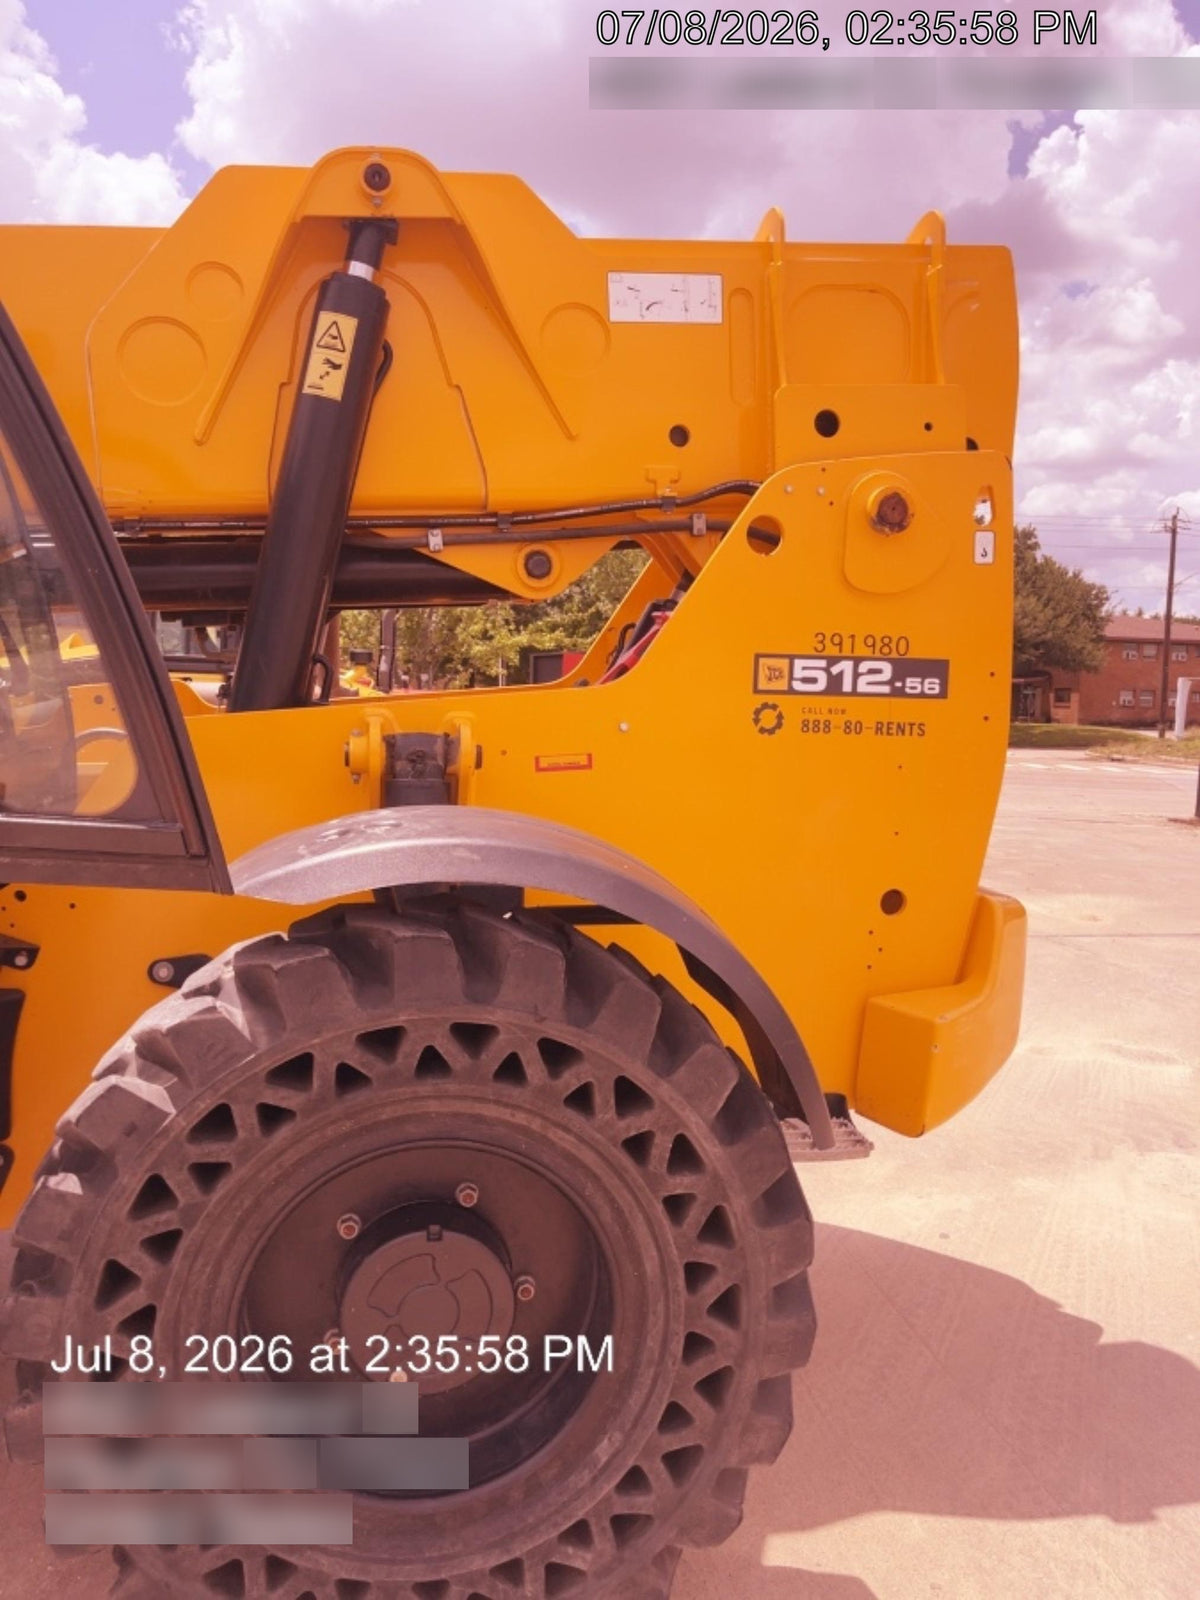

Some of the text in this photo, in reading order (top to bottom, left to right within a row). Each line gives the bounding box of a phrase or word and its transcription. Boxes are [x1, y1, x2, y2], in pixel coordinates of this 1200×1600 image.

[813, 632, 910, 656] 391980
[791, 658, 940, 694] 512-56
[801, 706, 847, 715] CALL NOW
[801, 718, 926, 737] 888-80-RENTS
